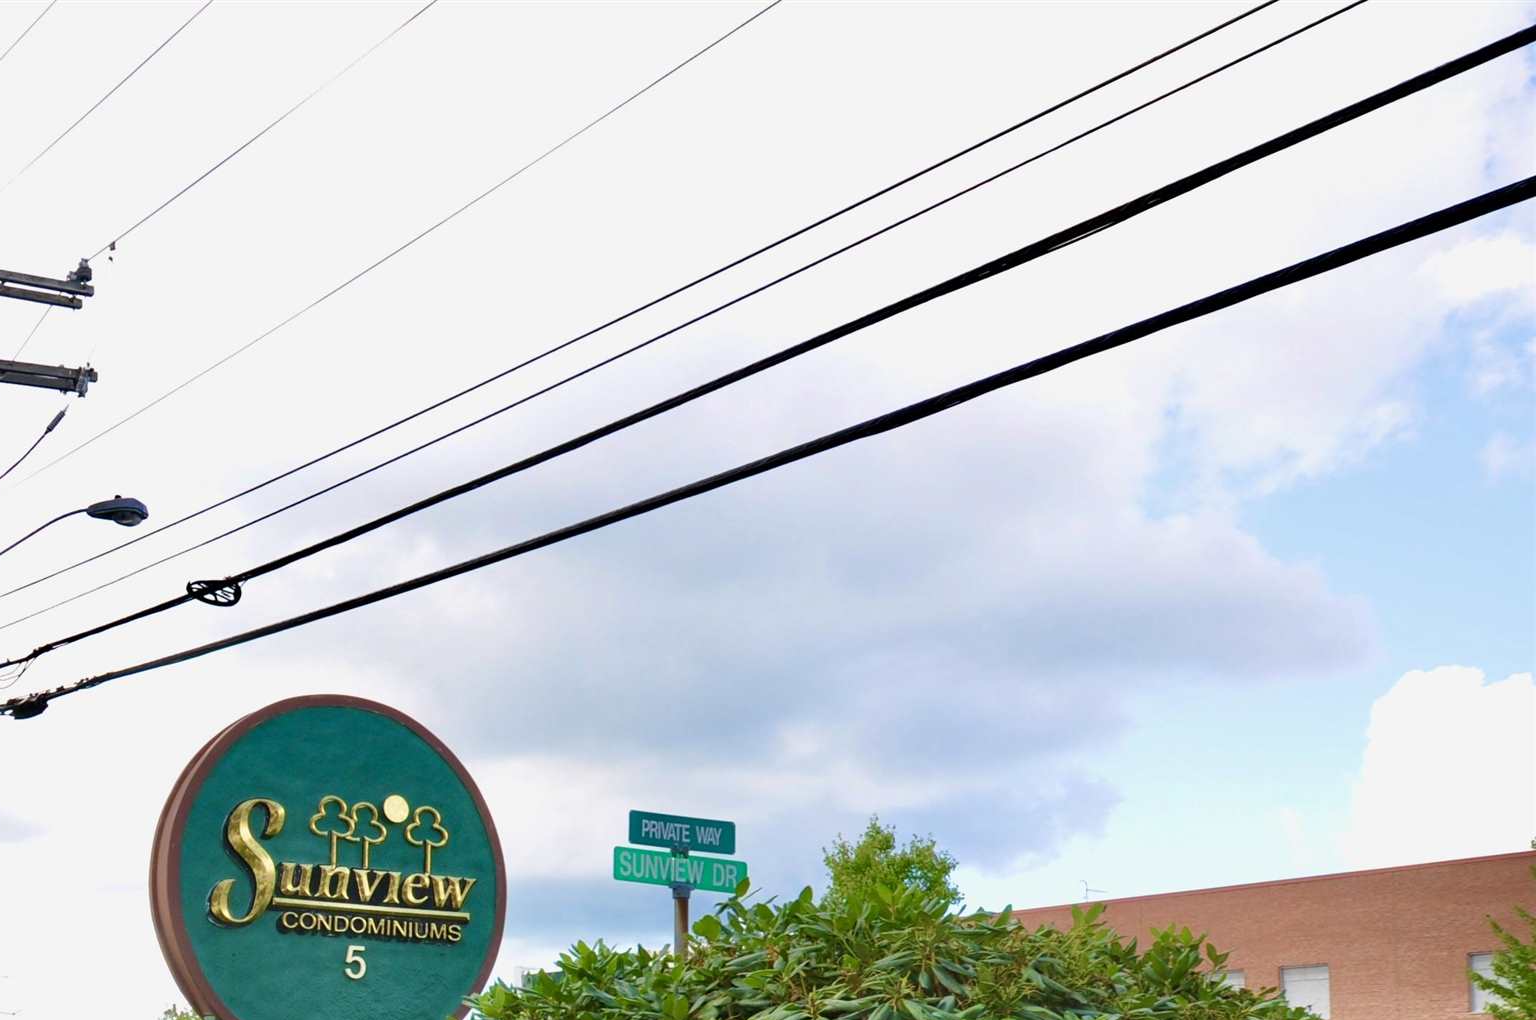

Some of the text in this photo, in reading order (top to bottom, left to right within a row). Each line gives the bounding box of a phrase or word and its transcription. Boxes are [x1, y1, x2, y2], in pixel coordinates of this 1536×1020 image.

[641, 819, 722, 846] PRIVATE WAY
[210, 798, 476, 923] Sunview
[619, 850, 738, 888] SUNVIEW DR
[281, 911, 462, 942] CONDOMINIUMS
[344, 945, 367, 980] 5
